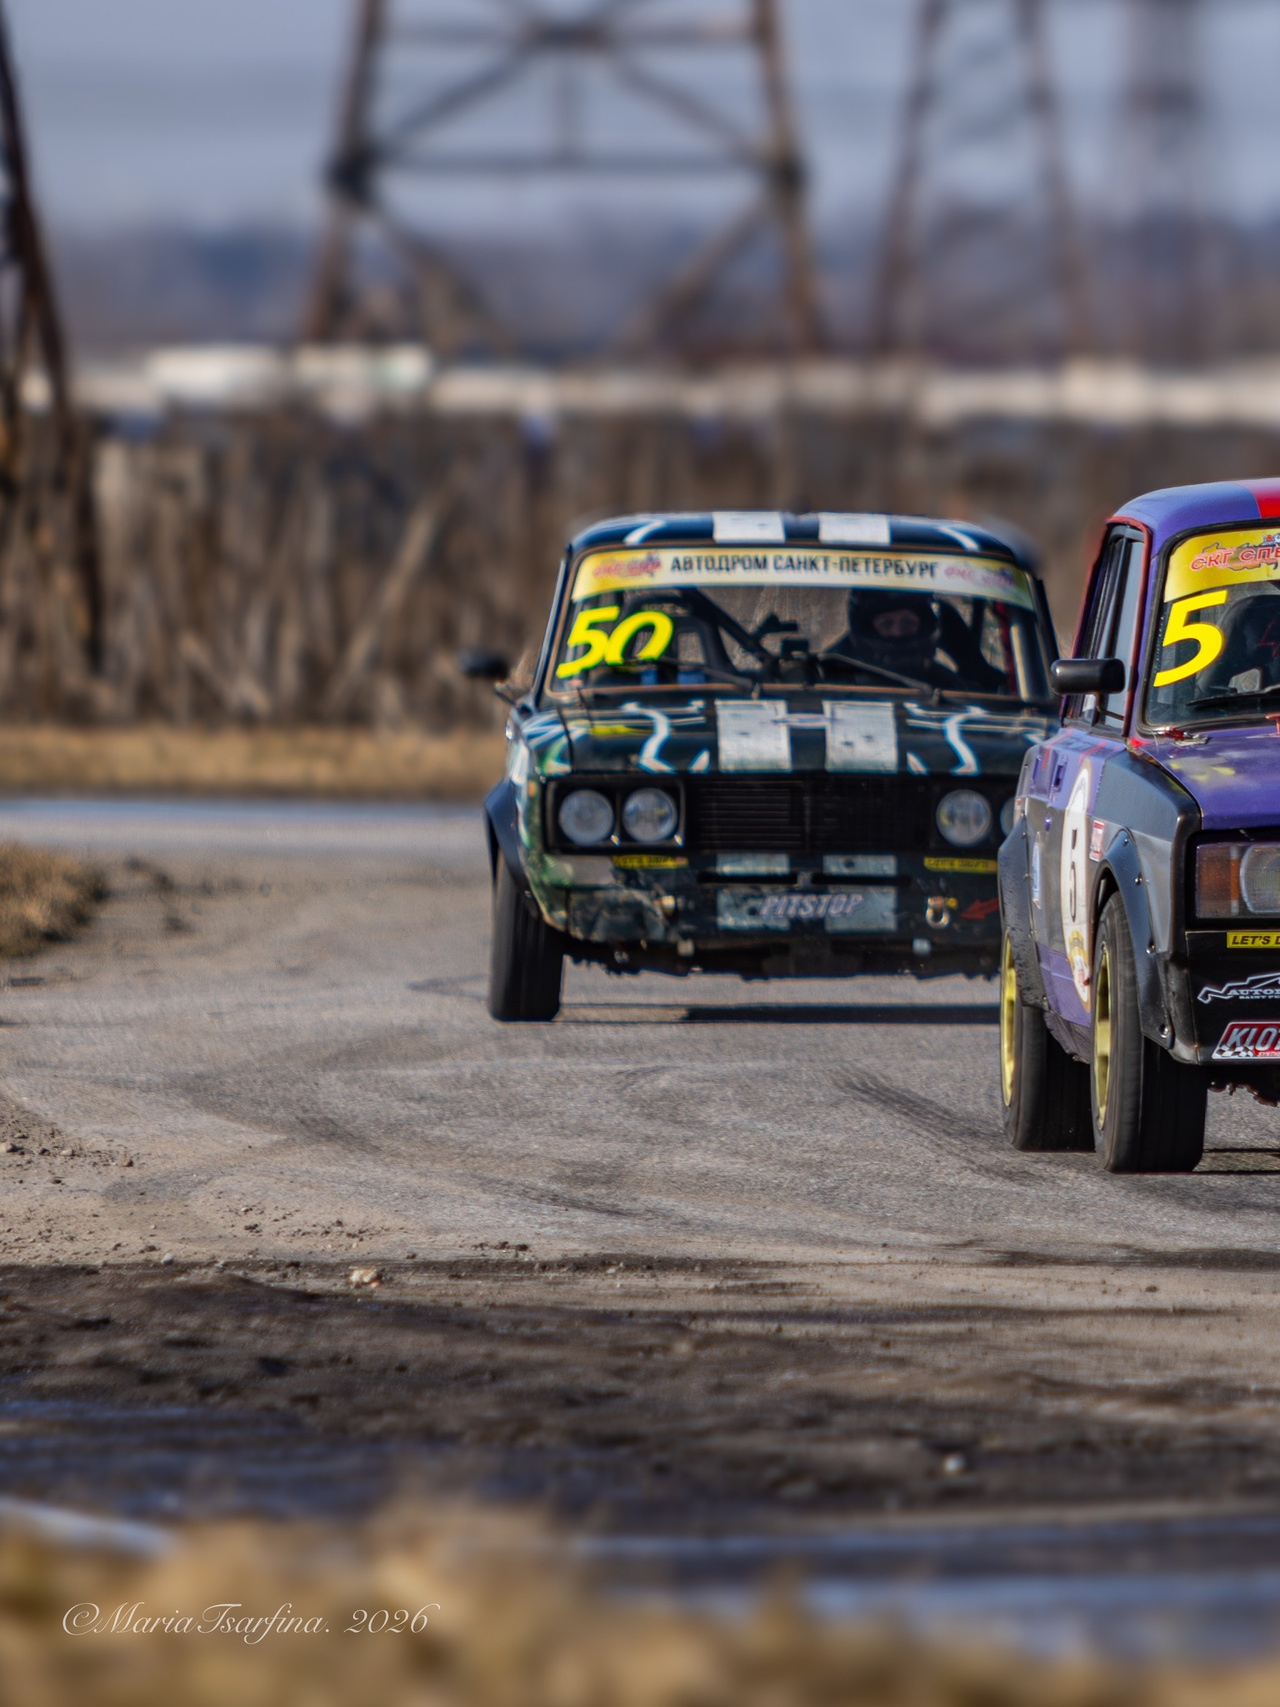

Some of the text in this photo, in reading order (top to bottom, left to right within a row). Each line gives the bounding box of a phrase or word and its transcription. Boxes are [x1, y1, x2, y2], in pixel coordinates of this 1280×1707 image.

[671, 555, 768, 573] АВТОДРОМ
[773, 555, 939, 578] САНКТ-ПЕТЕРБУРГ
[1190, 550, 1234, 571] СКГ
[556, 606, 674, 679] 50
[1153, 589, 1228, 688] 5
[760, 893, 863, 917] PITSTOP
[1232, 935, 1271, 945] LET'S
